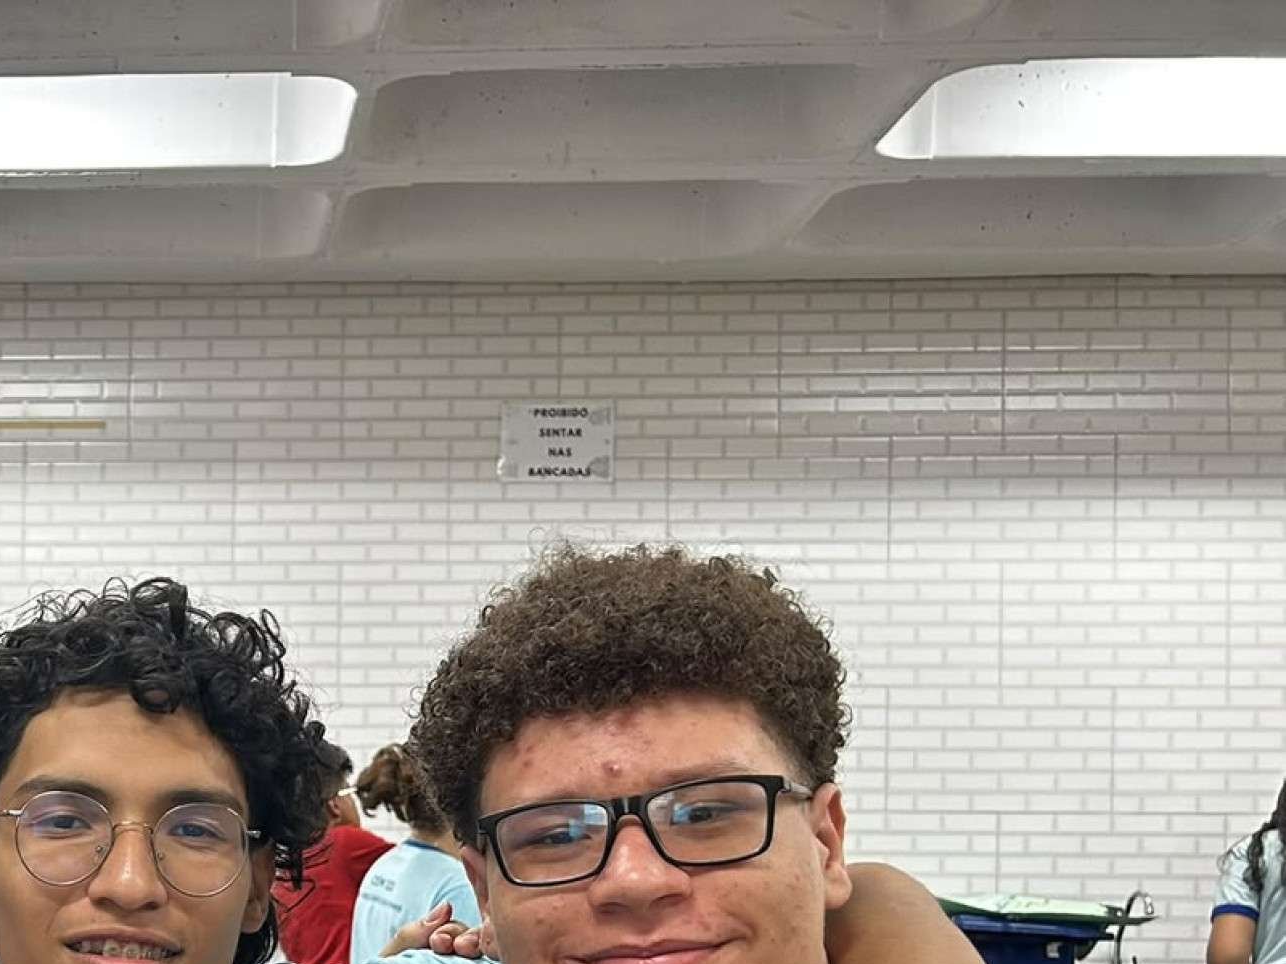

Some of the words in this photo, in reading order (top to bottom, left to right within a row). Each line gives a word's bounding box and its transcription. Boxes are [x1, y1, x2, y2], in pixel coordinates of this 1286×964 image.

[533, 407, 589, 418] PROIBIDO
[539, 427, 582, 437] SENTAR
[547, 447, 572, 457] NAS
[528, 467, 591, 477] BANCADAS
